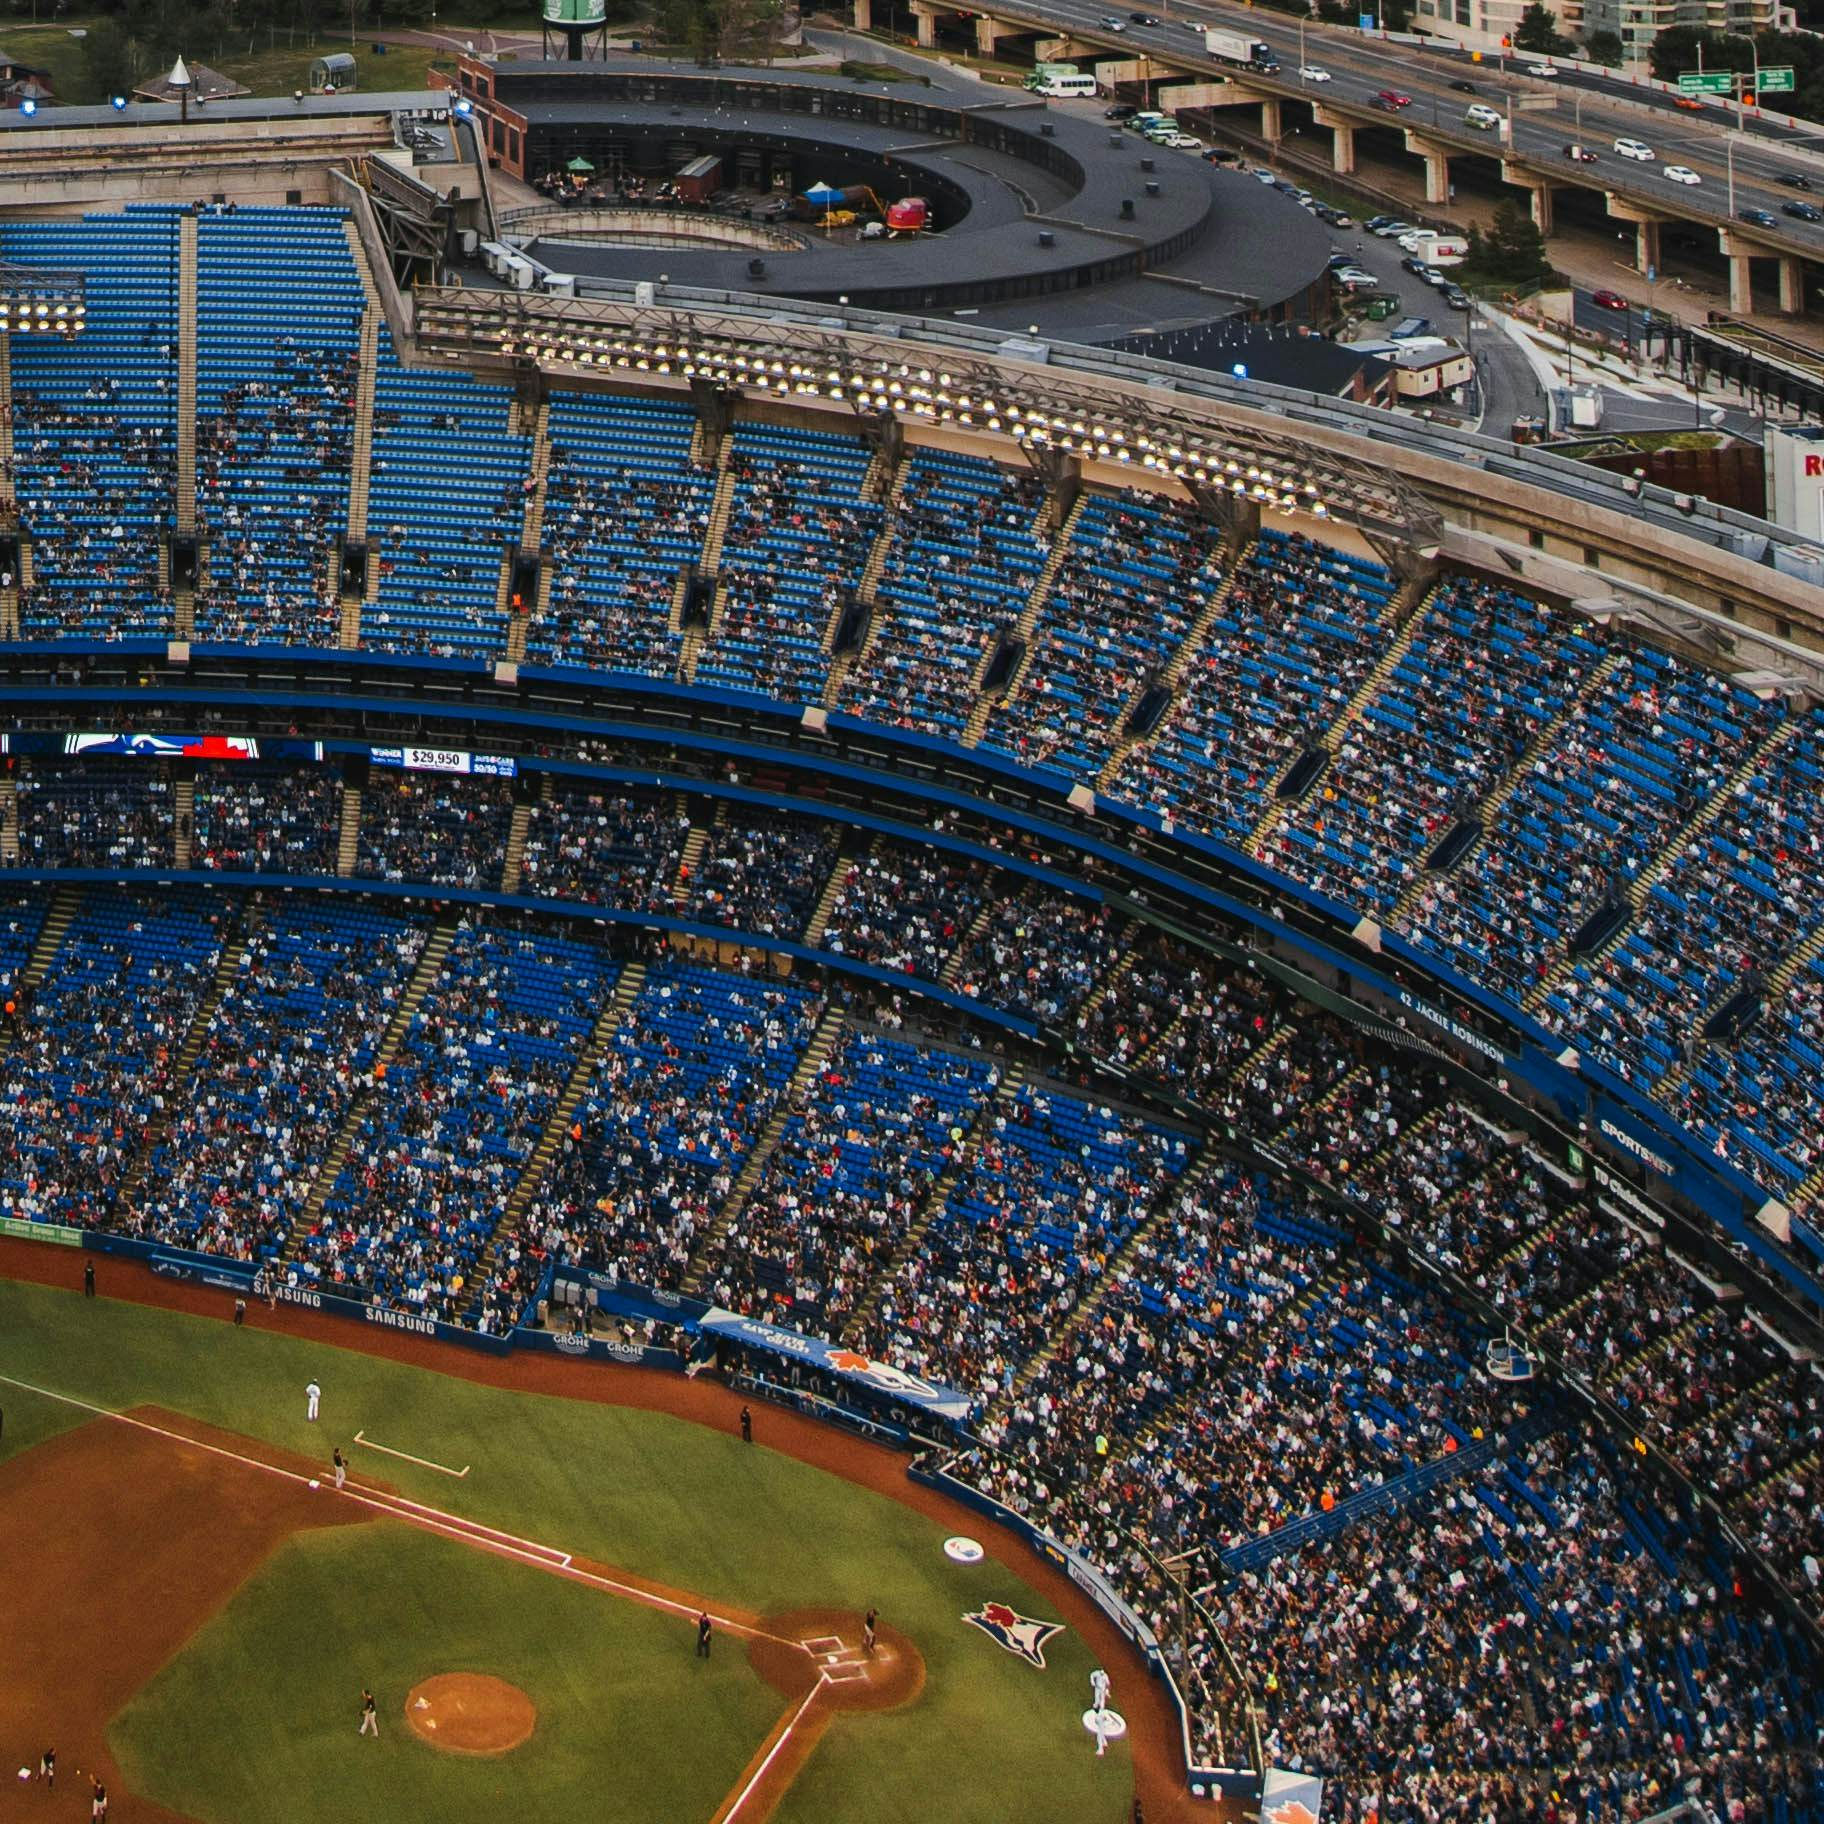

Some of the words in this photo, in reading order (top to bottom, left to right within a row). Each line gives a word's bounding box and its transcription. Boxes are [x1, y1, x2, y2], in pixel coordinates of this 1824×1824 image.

[1805, 454, 1824, 476] R
[412, 750, 460, 766] $29,950
[1400, 992, 1412, 1007] 42
[1416, 1001, 1449, 1031] JACKIE
[1452, 1022, 1505, 1064] ROBINSON
[1601, 1119, 1675, 1177] SPORTSNET
[253, 1280, 321, 1308] SAMSUNG
[365, 1307, 436, 1335] SAMSUNG
[553, 1334, 590, 1348] GROHE
[607, 1343, 644, 1356] GROHE
